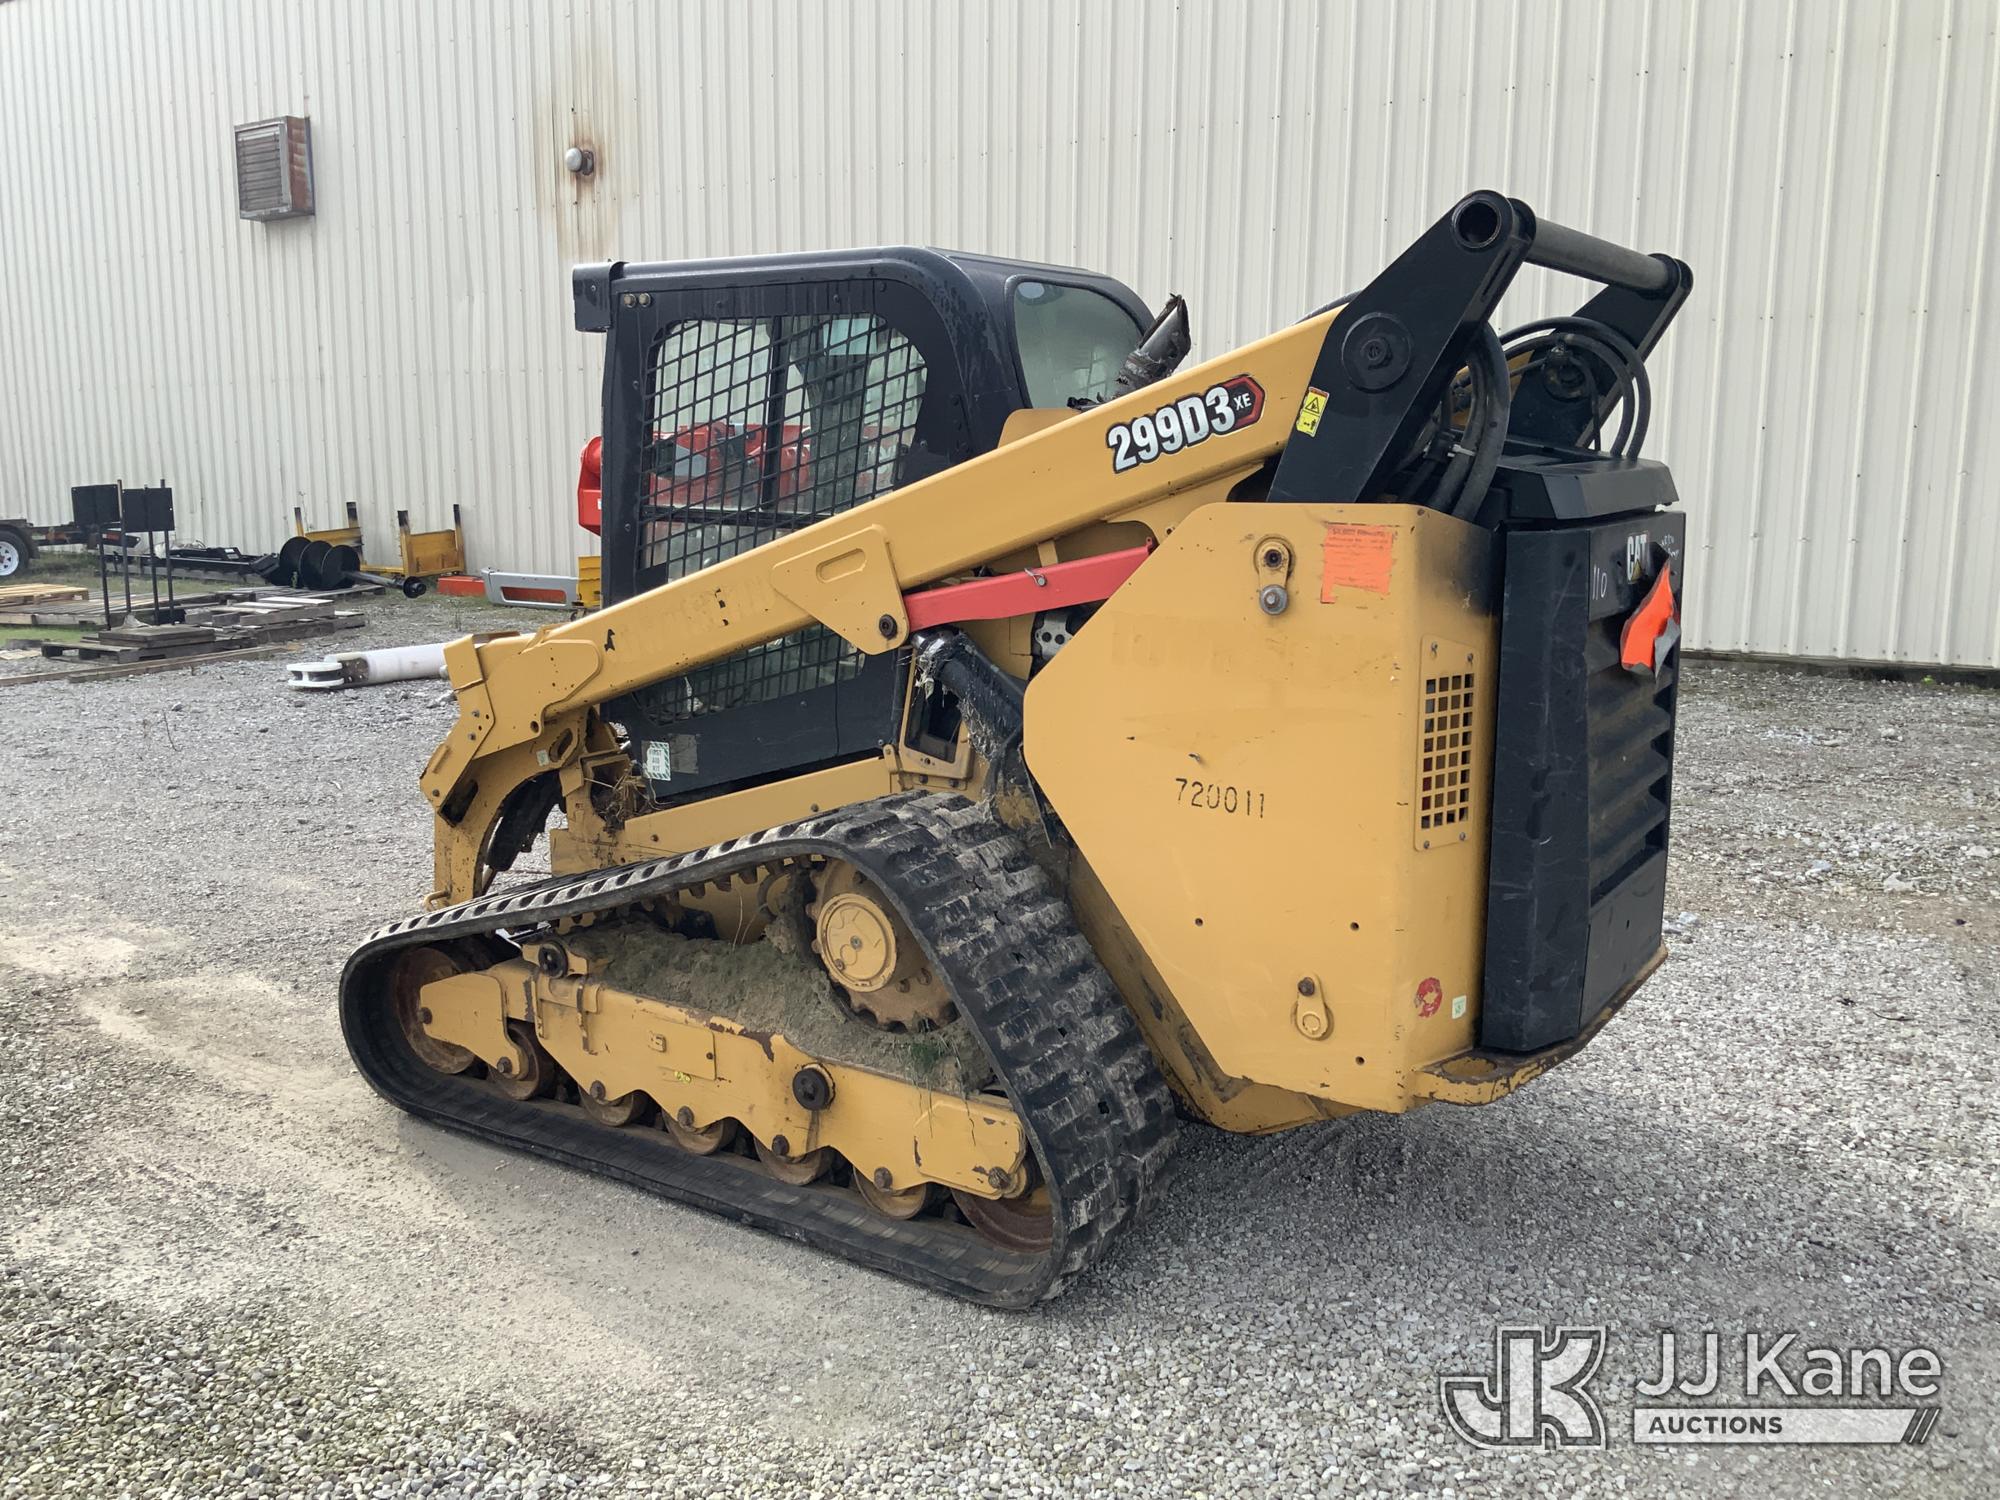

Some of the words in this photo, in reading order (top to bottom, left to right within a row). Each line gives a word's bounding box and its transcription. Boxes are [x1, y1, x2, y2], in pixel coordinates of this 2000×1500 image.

[1108, 386, 1236, 472] 299D3
[1233, 392, 1252, 411] XE
[1627, 533, 1649, 582] CAT
[1176, 777, 1264, 819] 720011
